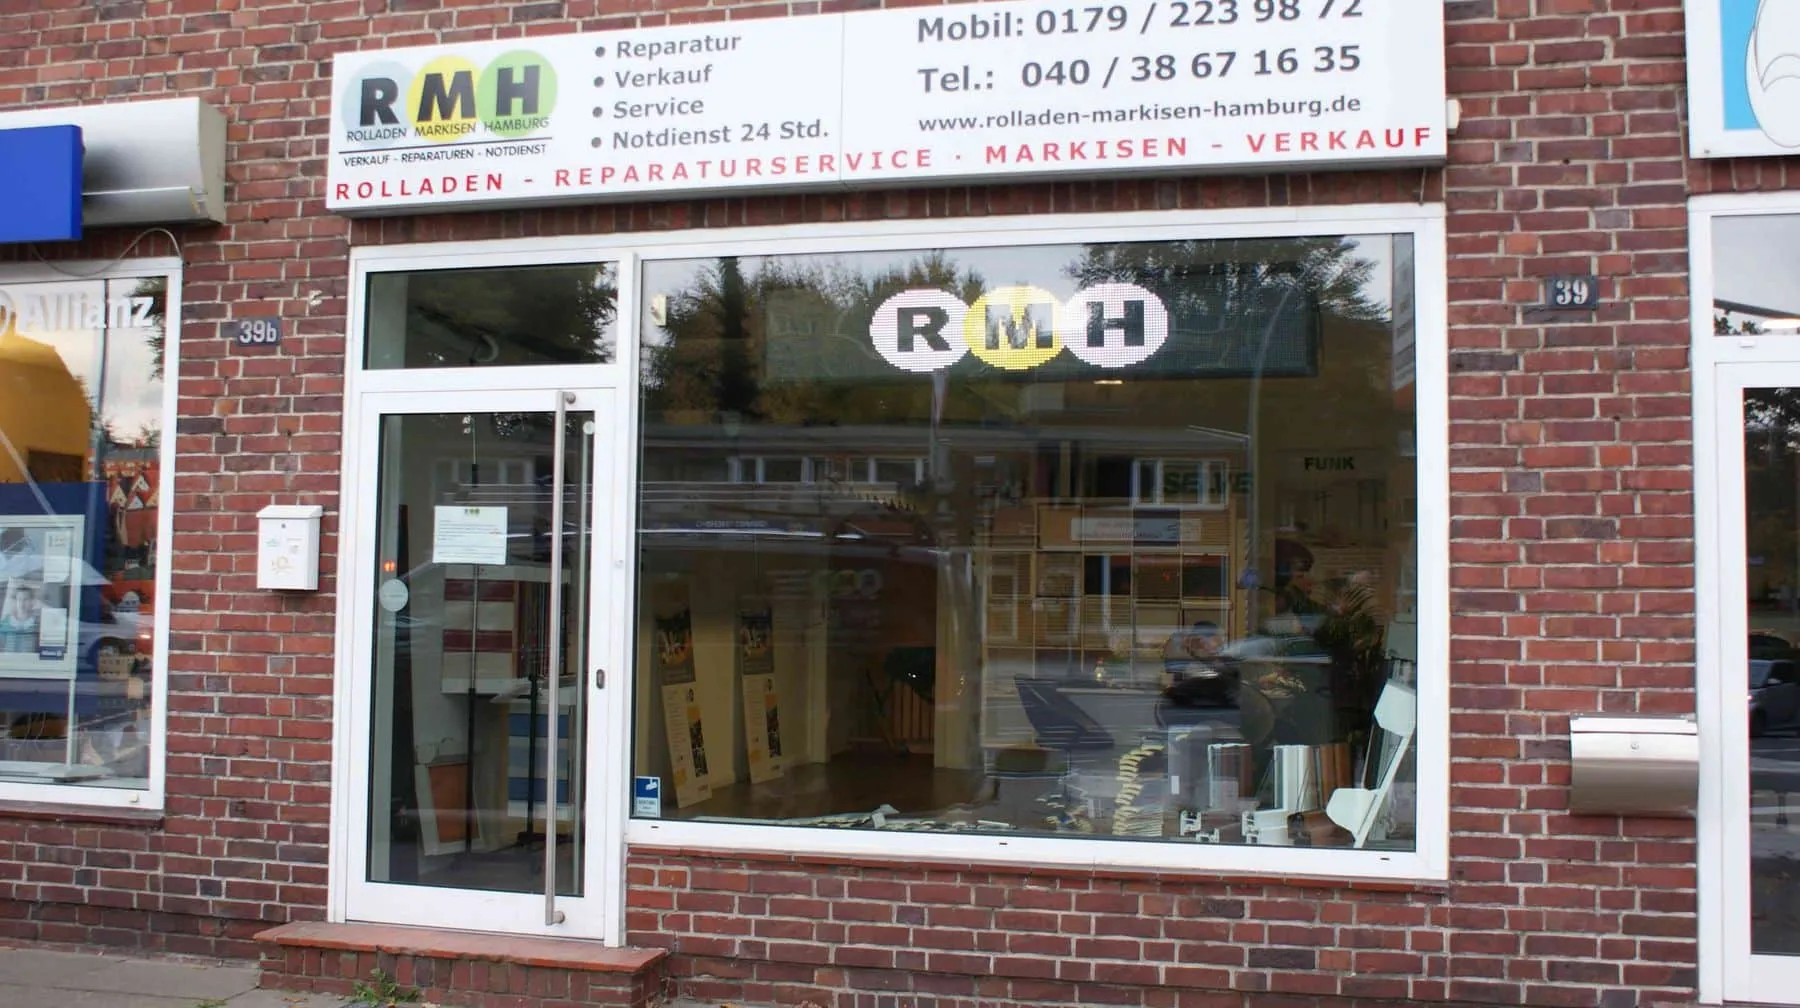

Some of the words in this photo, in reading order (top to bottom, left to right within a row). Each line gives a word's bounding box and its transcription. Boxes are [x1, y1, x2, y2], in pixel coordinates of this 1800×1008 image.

[918, 11, 1024, 42] Mobil:
[1036, 5, 1128, 35] 0179
[1169, 0, 1238, 27] 223
[1253, 0, 1300, 23] 98
[616, 34, 742, 60] Reparatur
[615, 64, 713, 88] Verkauf
[917, 65, 994, 93] Tel.:
[1021, 59, 1090, 88] 040
[1130, 54, 1176, 81] 38
[1191, 51, 1236, 78] 67
[1253, 48, 1299, 76] 16
[1313, 45, 1361, 72] 35
[613, 97, 704, 119] Service
[918, 95, 1361, 131] www.rolladen-markisen-hamburg.de
[346, 127, 407, 142] ROLLADEN
[414, 121, 477, 137] MARKISEN
[483, 117, 550, 133] HAMBURG
[612, 124, 731, 149] Notdienst
[740, 122, 771, 142] 24
[779, 119, 829, 140] Std.
[336, 173, 503, 201] ROLLADEN
[556, 149, 934, 187] REPARATURSERVICE
[985, 137, 1188, 165] MARKISEN
[1247, 127, 1431, 153] VERKAUF
[343, 154, 391, 168] VERKAUF
[400, 148, 474, 163] REPARATUREN
[485, 144, 547, 158] NOTDIENST
[1556, 279, 1589, 305] 39
[19, 292, 154, 332] Allianz
[239, 319, 277, 343] 39b
[1303, 456, 1355, 470] FUNK
